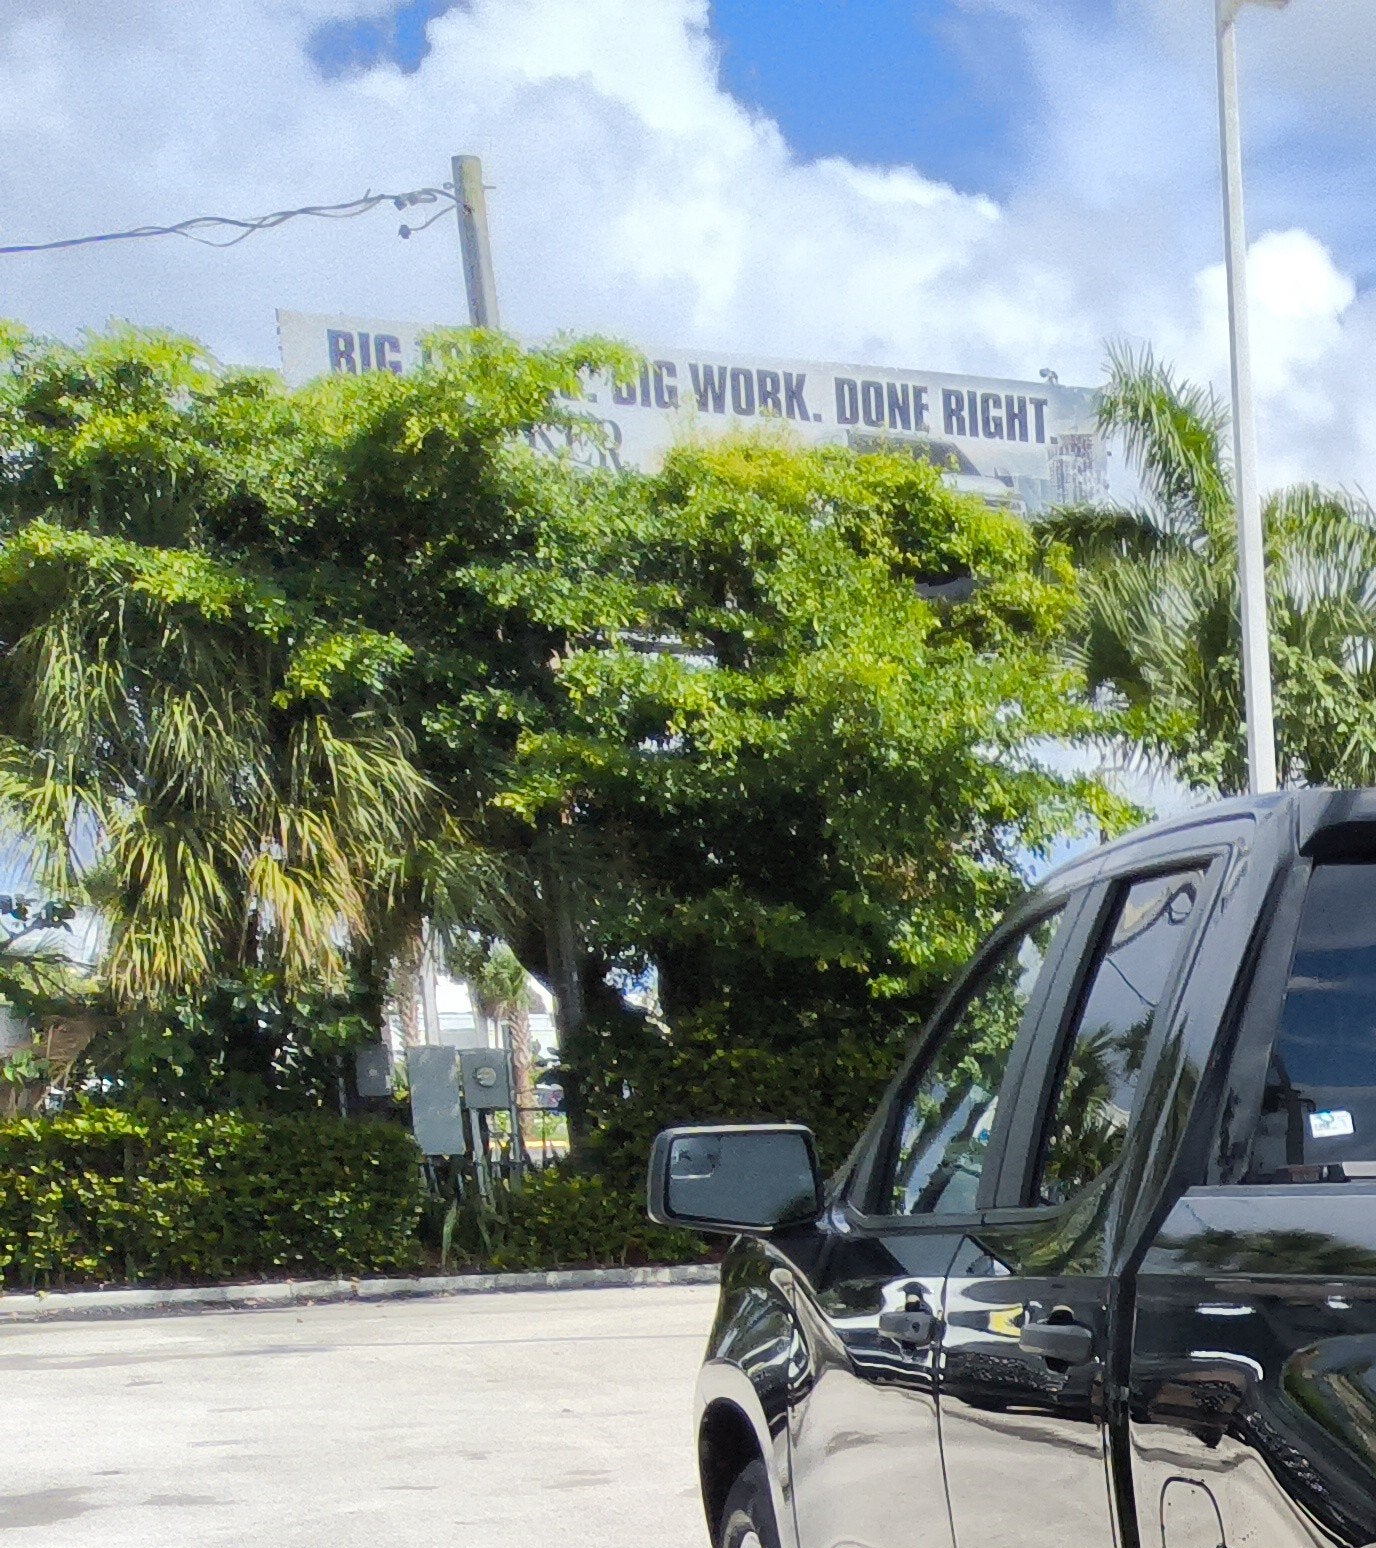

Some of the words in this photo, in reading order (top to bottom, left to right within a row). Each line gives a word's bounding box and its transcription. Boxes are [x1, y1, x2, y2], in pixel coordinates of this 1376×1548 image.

[688, 363, 822, 422] WORK.
[834, 377, 929, 433] DONE
[942, 387, 1058, 444] RIGHT.
